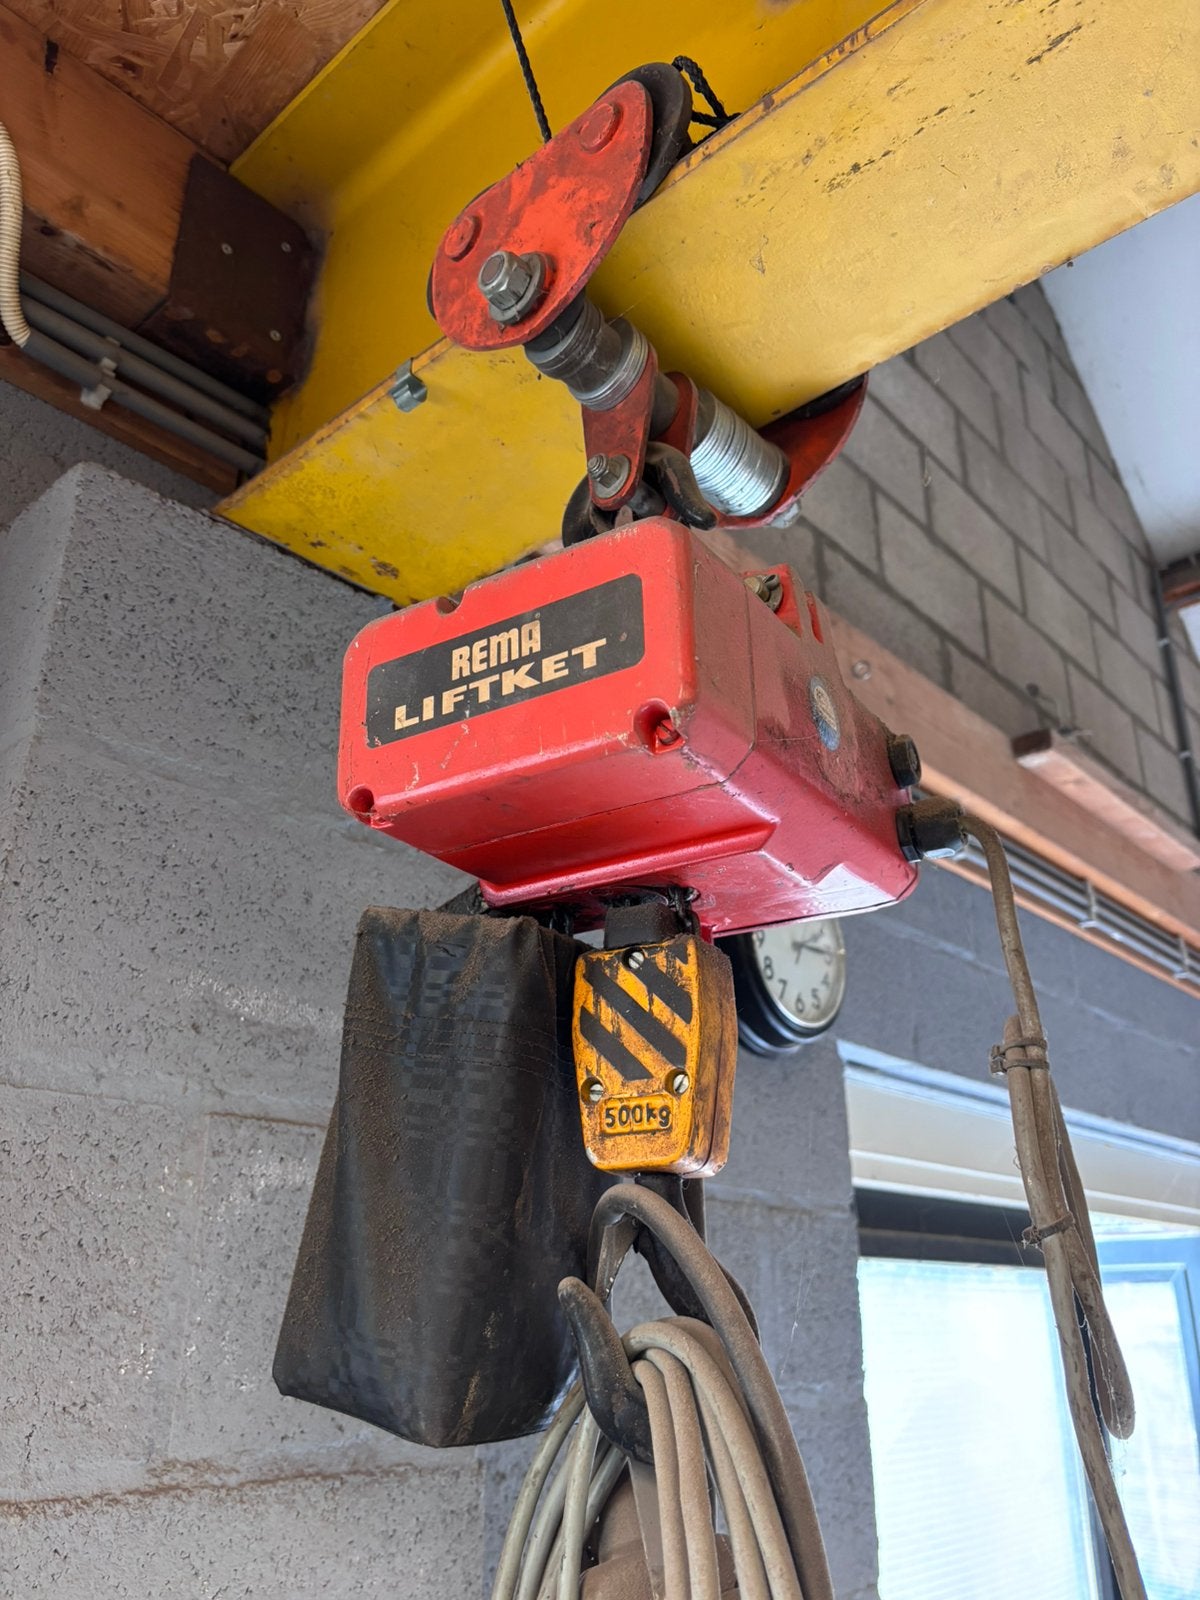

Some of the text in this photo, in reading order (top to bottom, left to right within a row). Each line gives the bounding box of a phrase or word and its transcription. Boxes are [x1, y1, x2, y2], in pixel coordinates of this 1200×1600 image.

[452, 620, 541, 681] REMA
[394, 638, 607, 731] LIFTKET
[755, 930, 766, 948] 9
[763, 955, 774, 980] 8
[778, 978, 788, 999] 7
[811, 987, 821, 1010] 5
[795, 992, 805, 1013] 6
[605, 1103, 671, 1128] 500kg
